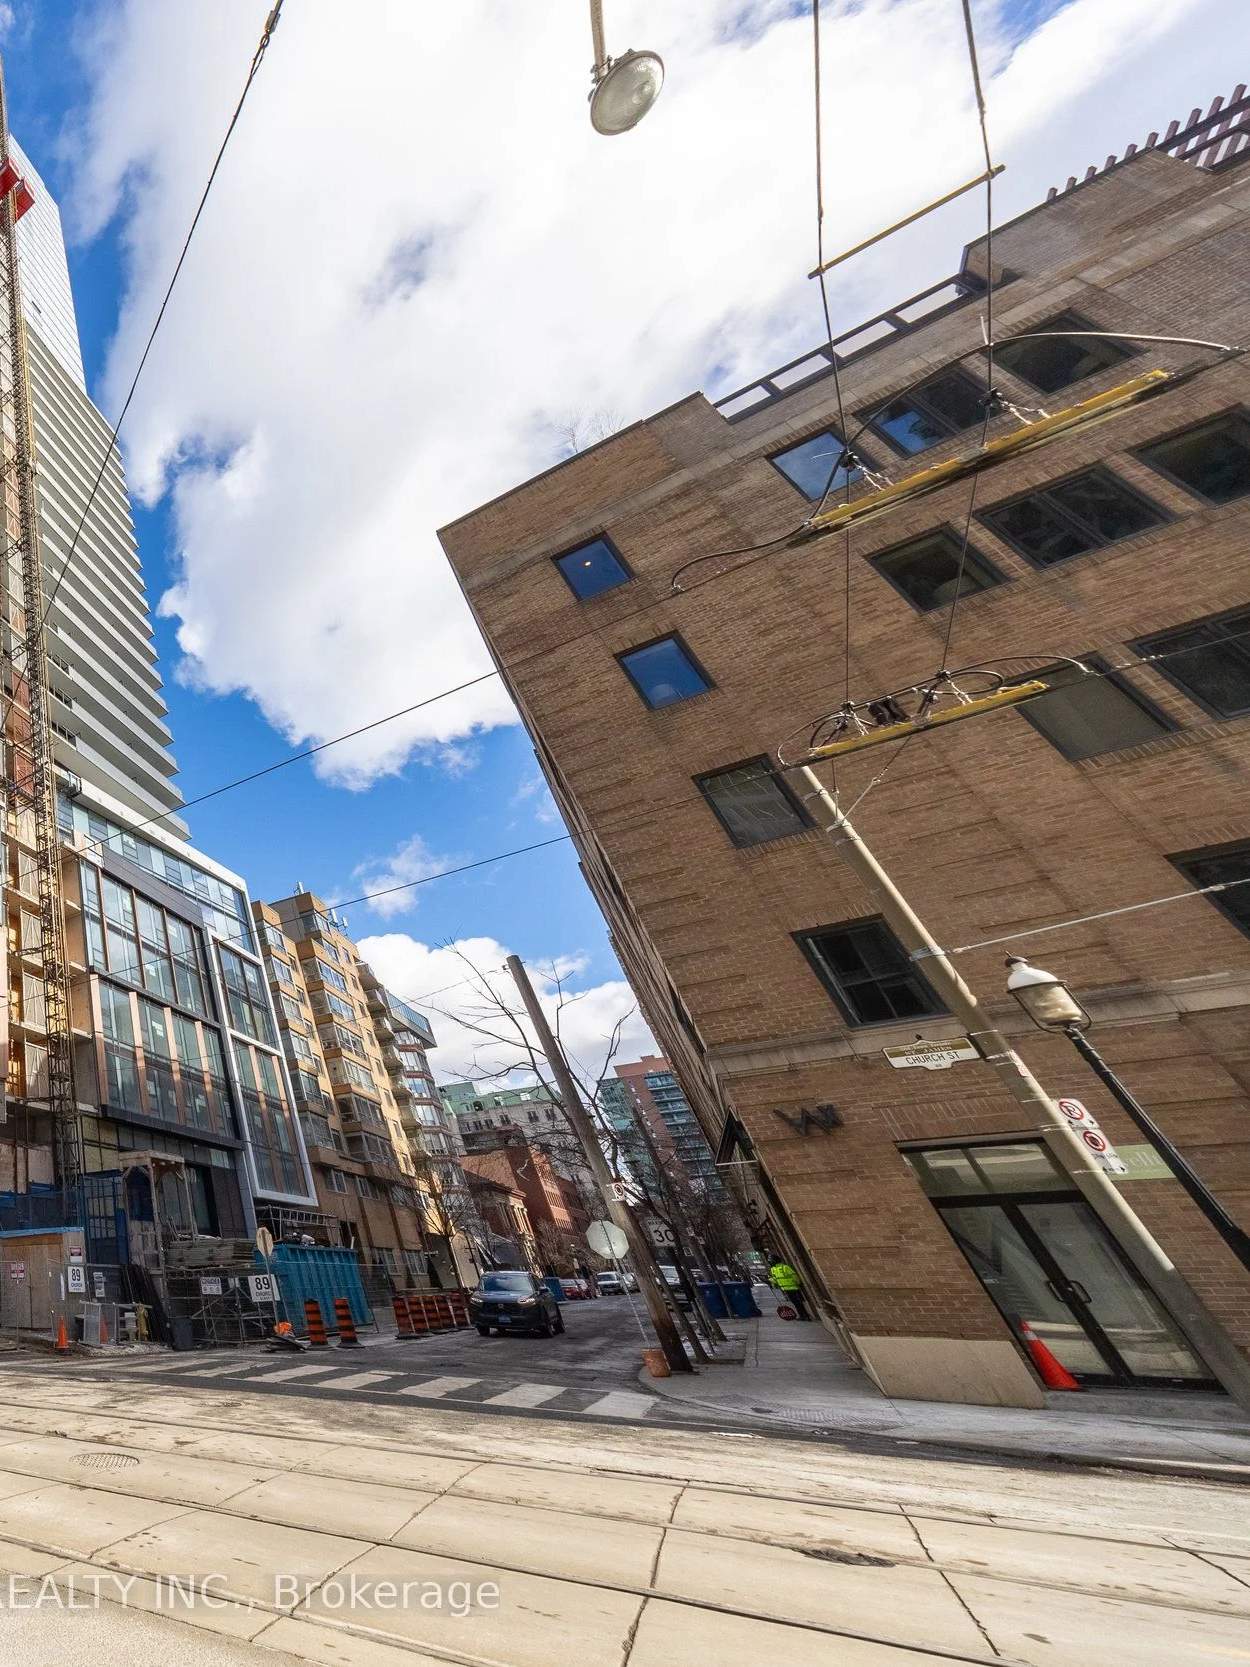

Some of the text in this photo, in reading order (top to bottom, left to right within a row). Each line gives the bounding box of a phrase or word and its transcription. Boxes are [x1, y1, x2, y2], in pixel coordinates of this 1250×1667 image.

[905, 1050, 964, 1065] CHURCH ST.
[653, 1229, 676, 1243] 30
[71, 1268, 81, 1281] 89
[254, 1276, 270, 1291] 89
